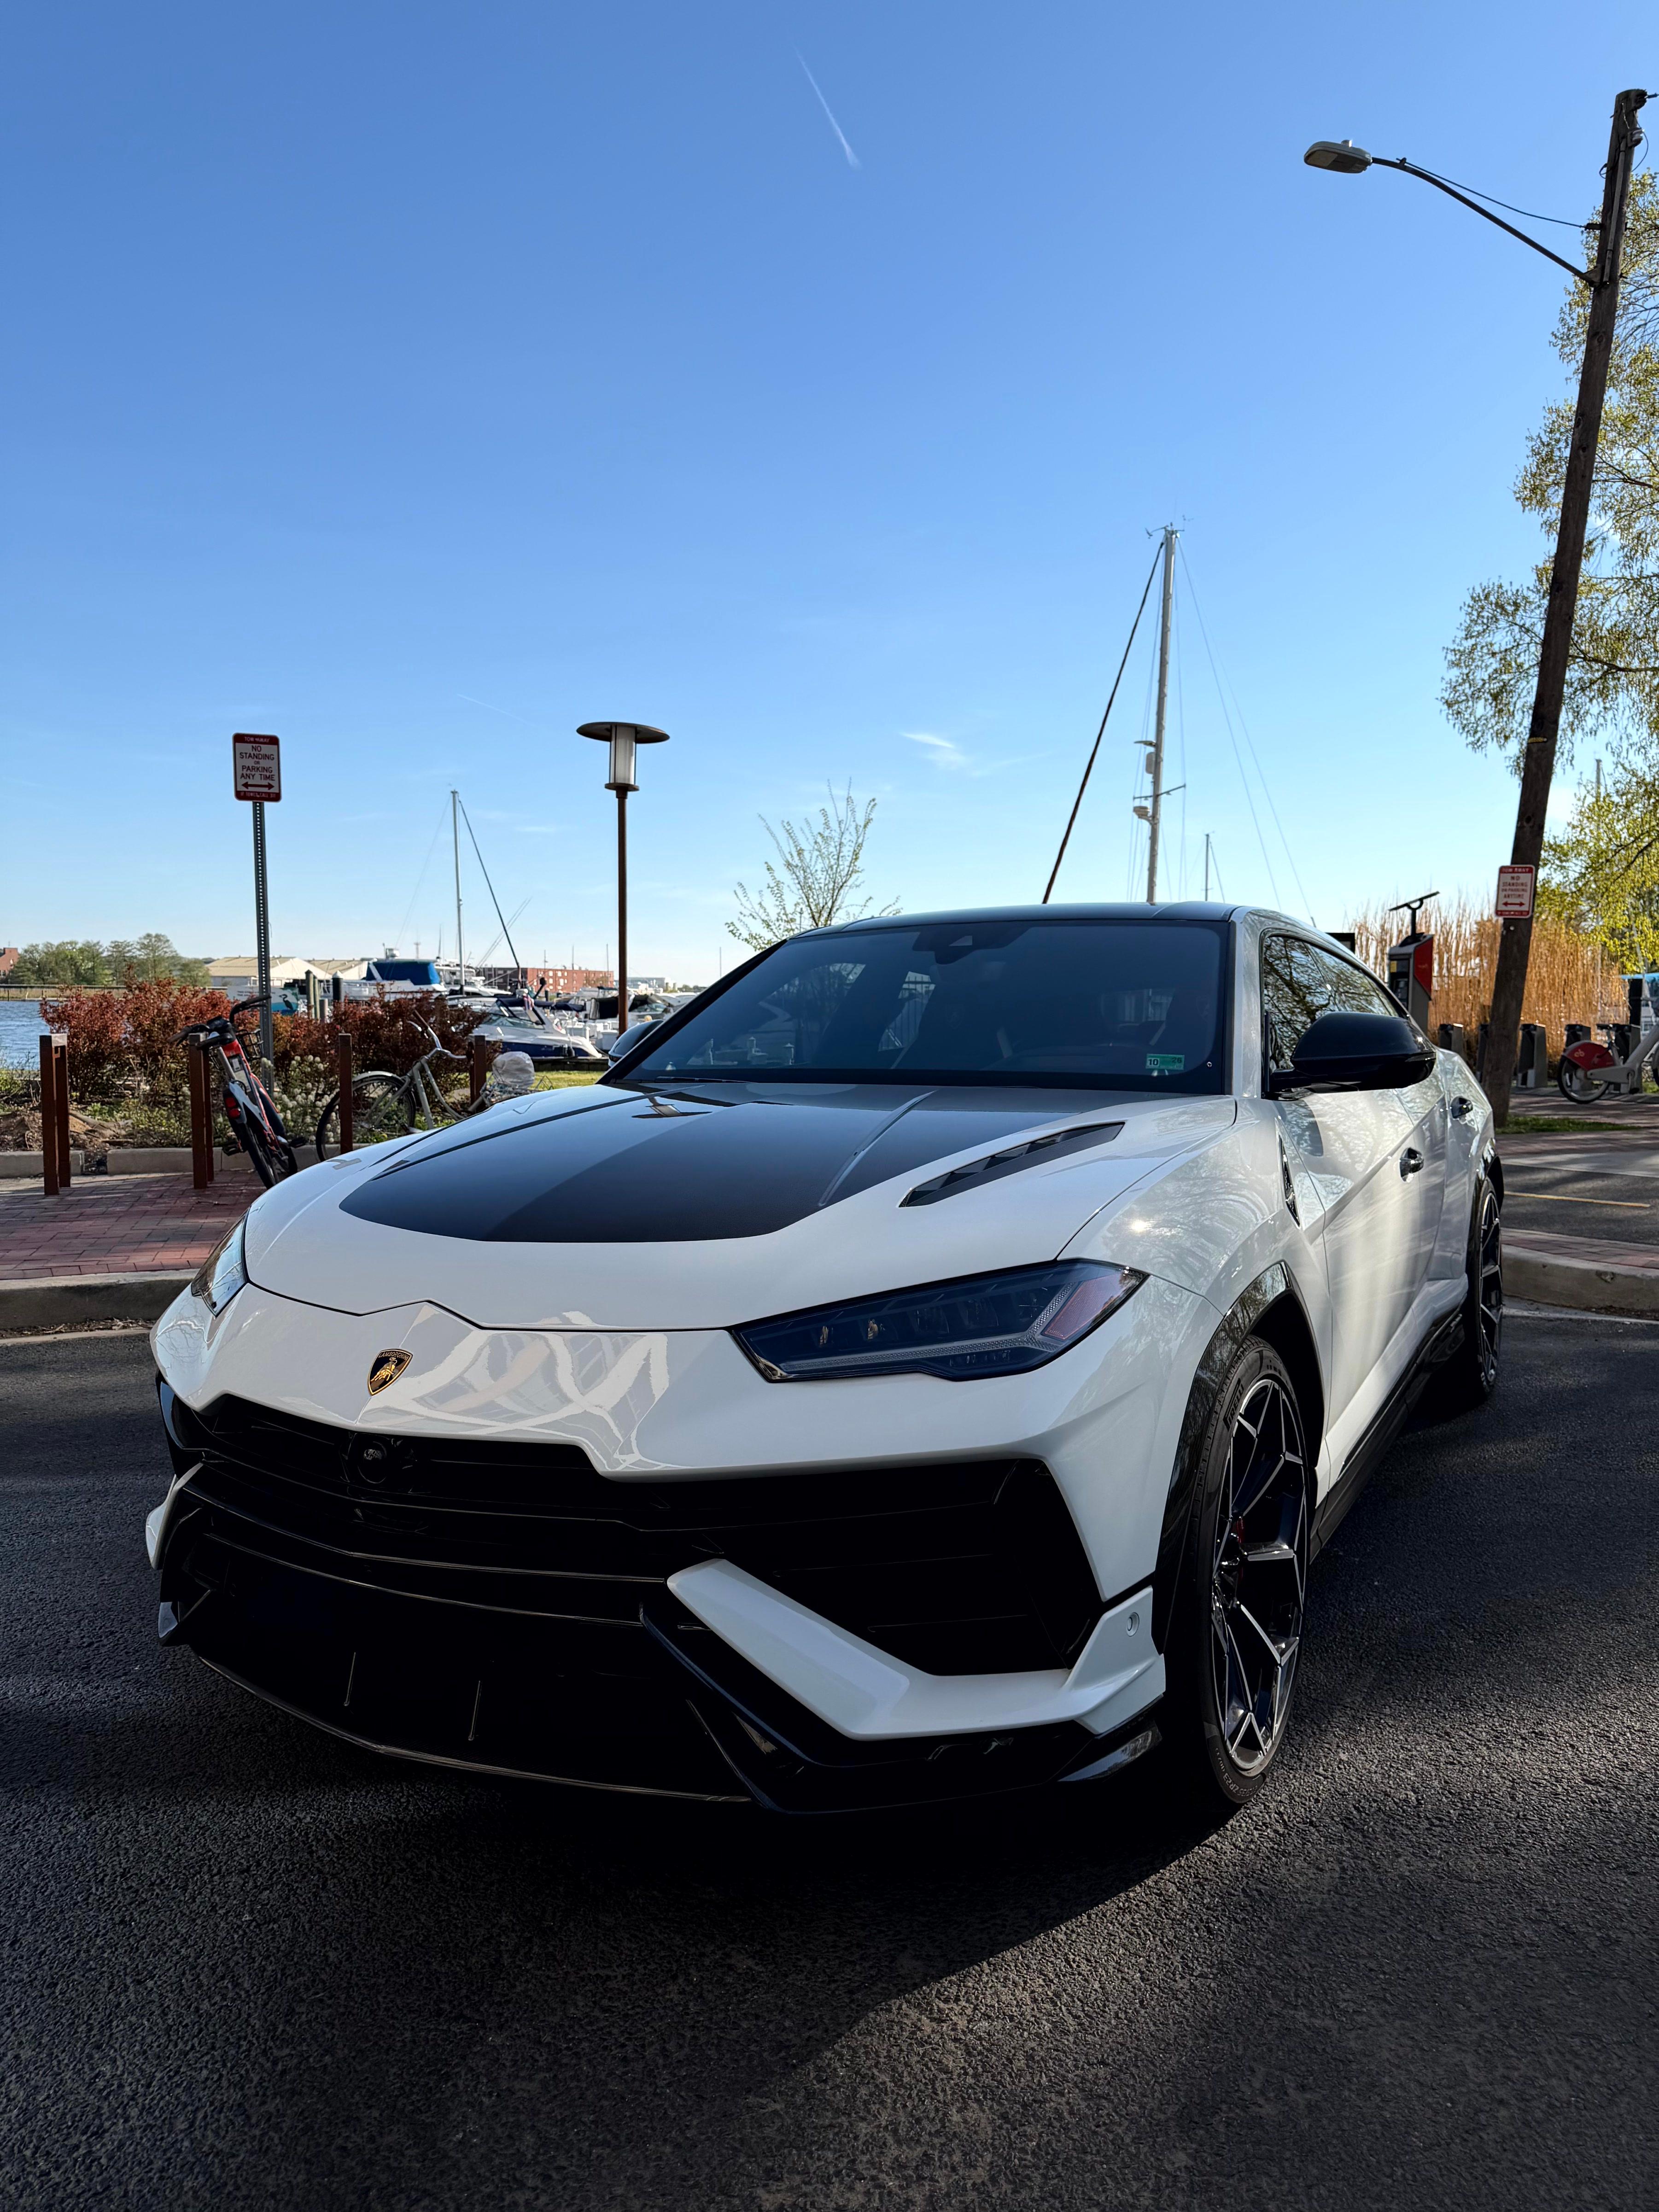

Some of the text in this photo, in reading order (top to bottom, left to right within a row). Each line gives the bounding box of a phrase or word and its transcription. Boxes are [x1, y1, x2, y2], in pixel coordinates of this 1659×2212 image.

[240, 752, 275, 760] STANDING
[242, 765, 273, 773] PARKING
[378, 1352, 409, 1360] LAMBORGHINI
[1223, 1377, 1244, 1431] PIRELLI
